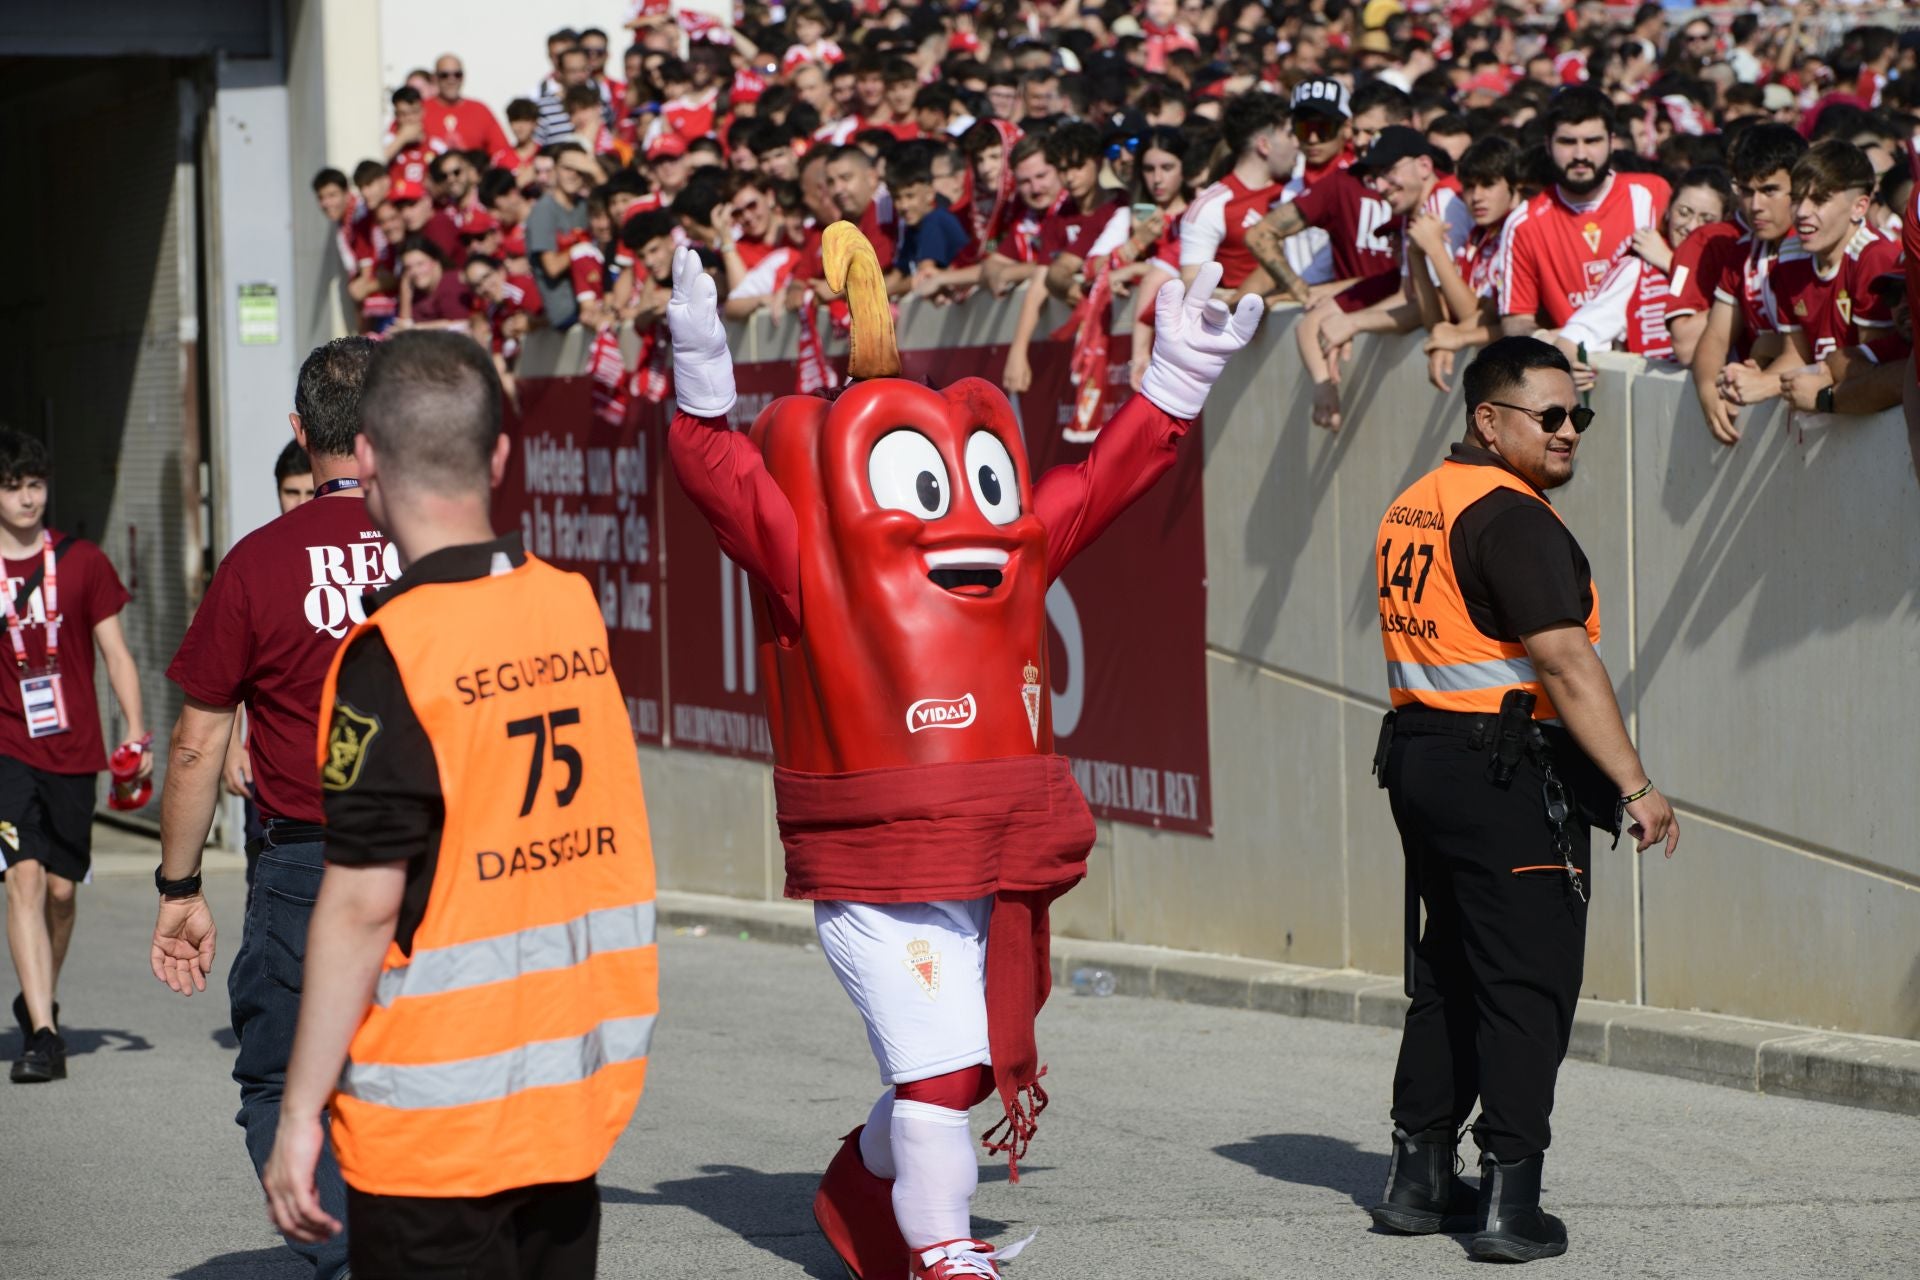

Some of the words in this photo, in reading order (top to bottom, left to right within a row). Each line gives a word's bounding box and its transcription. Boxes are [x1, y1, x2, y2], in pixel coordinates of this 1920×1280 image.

[1295, 81, 1338, 102] ICON
[523, 431, 585, 494] Métele
[586, 447, 613, 495] un
[614, 430, 647, 512] gol
[521, 511, 533, 551] a
[534, 497, 552, 557] la
[554, 498, 621, 562] factura
[623, 500, 649, 565] de
[1386, 505, 1444, 531] SEGURIDAD
[602, 565, 618, 629] la
[620, 567, 652, 632] luz
[1379, 538, 1435, 605] 147
[303, 584, 391, 640] QU
[455, 647, 609, 706] SEGURDAD
[916, 703, 969, 724] VIDAL
[506, 707, 583, 818] 75
[1163, 770, 1199, 821] REY
[476, 826, 617, 882] DASSGUR
